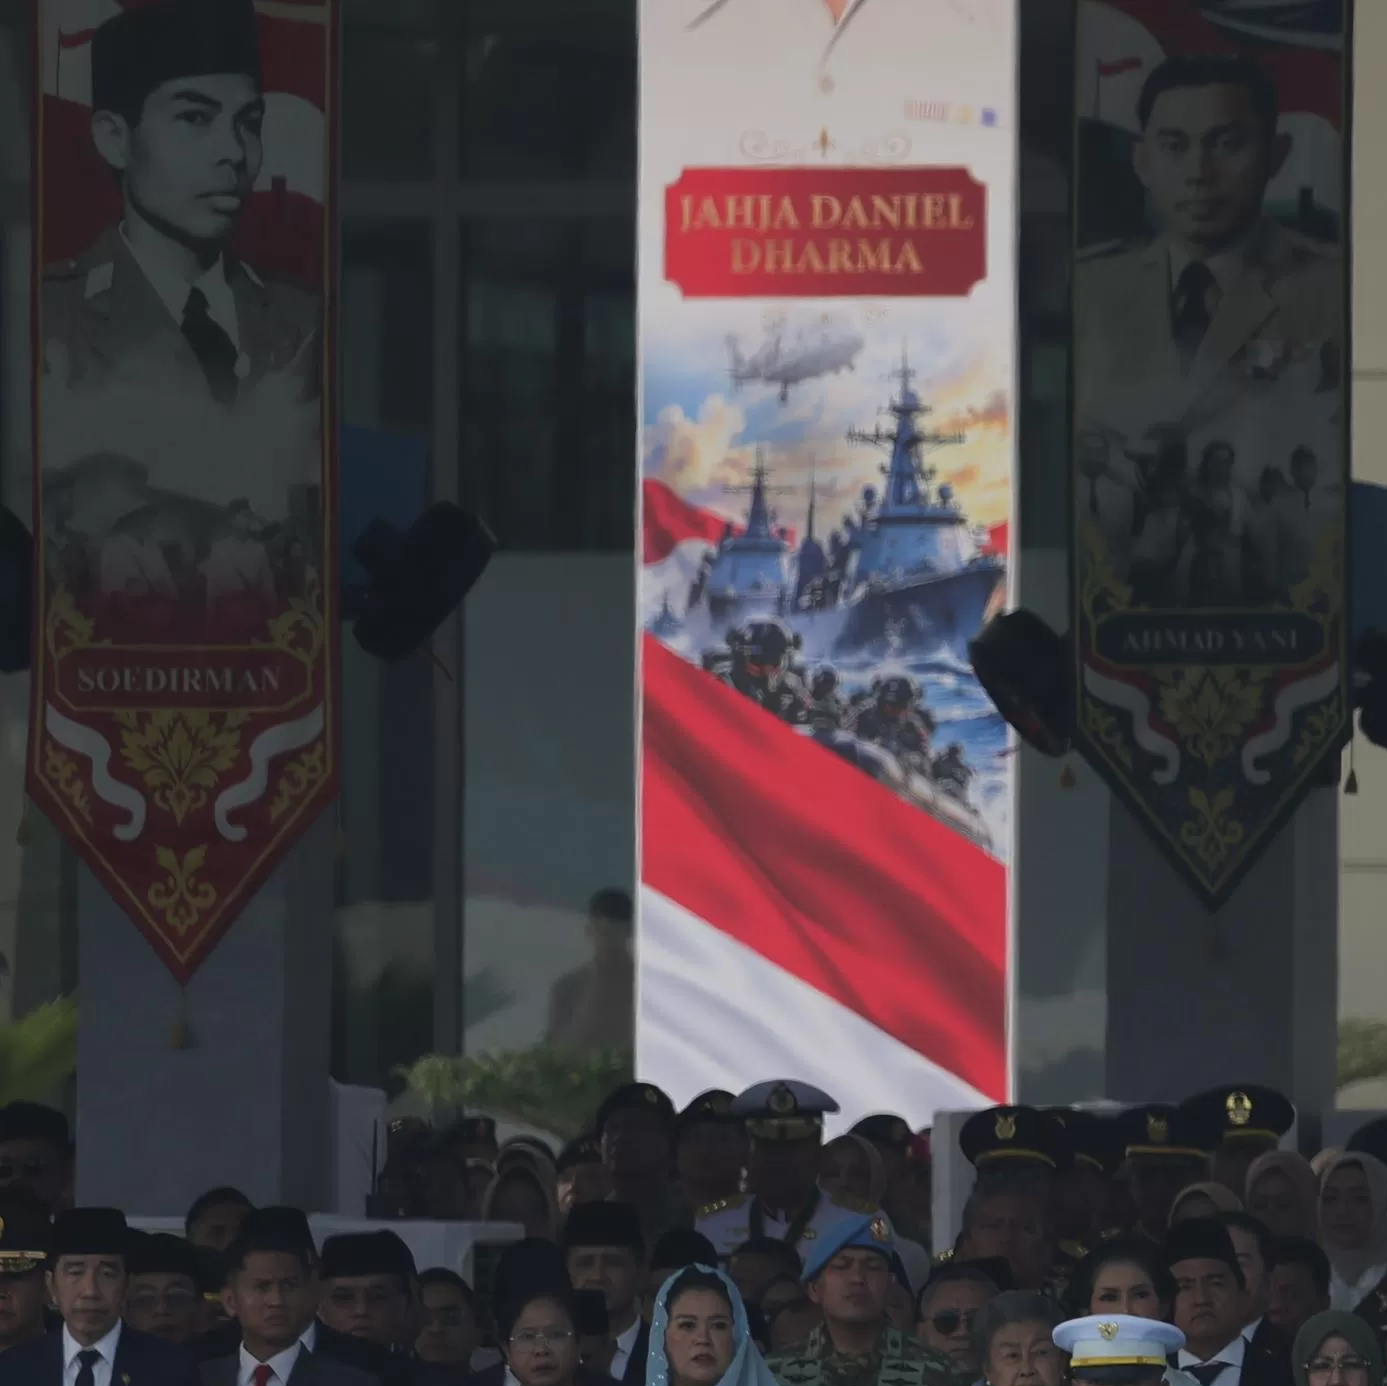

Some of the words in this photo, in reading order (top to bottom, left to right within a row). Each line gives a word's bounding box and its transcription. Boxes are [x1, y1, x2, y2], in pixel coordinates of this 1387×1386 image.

[680, 194, 799, 233] JAHJA
[809, 193, 974, 229] DANIEL
[731, 238, 924, 273] DHARMA
[1124, 628, 1225, 651] AHMAD
[1232, 628, 1297, 651] YANI
[76, 666, 280, 692] SOEDIRMAN
